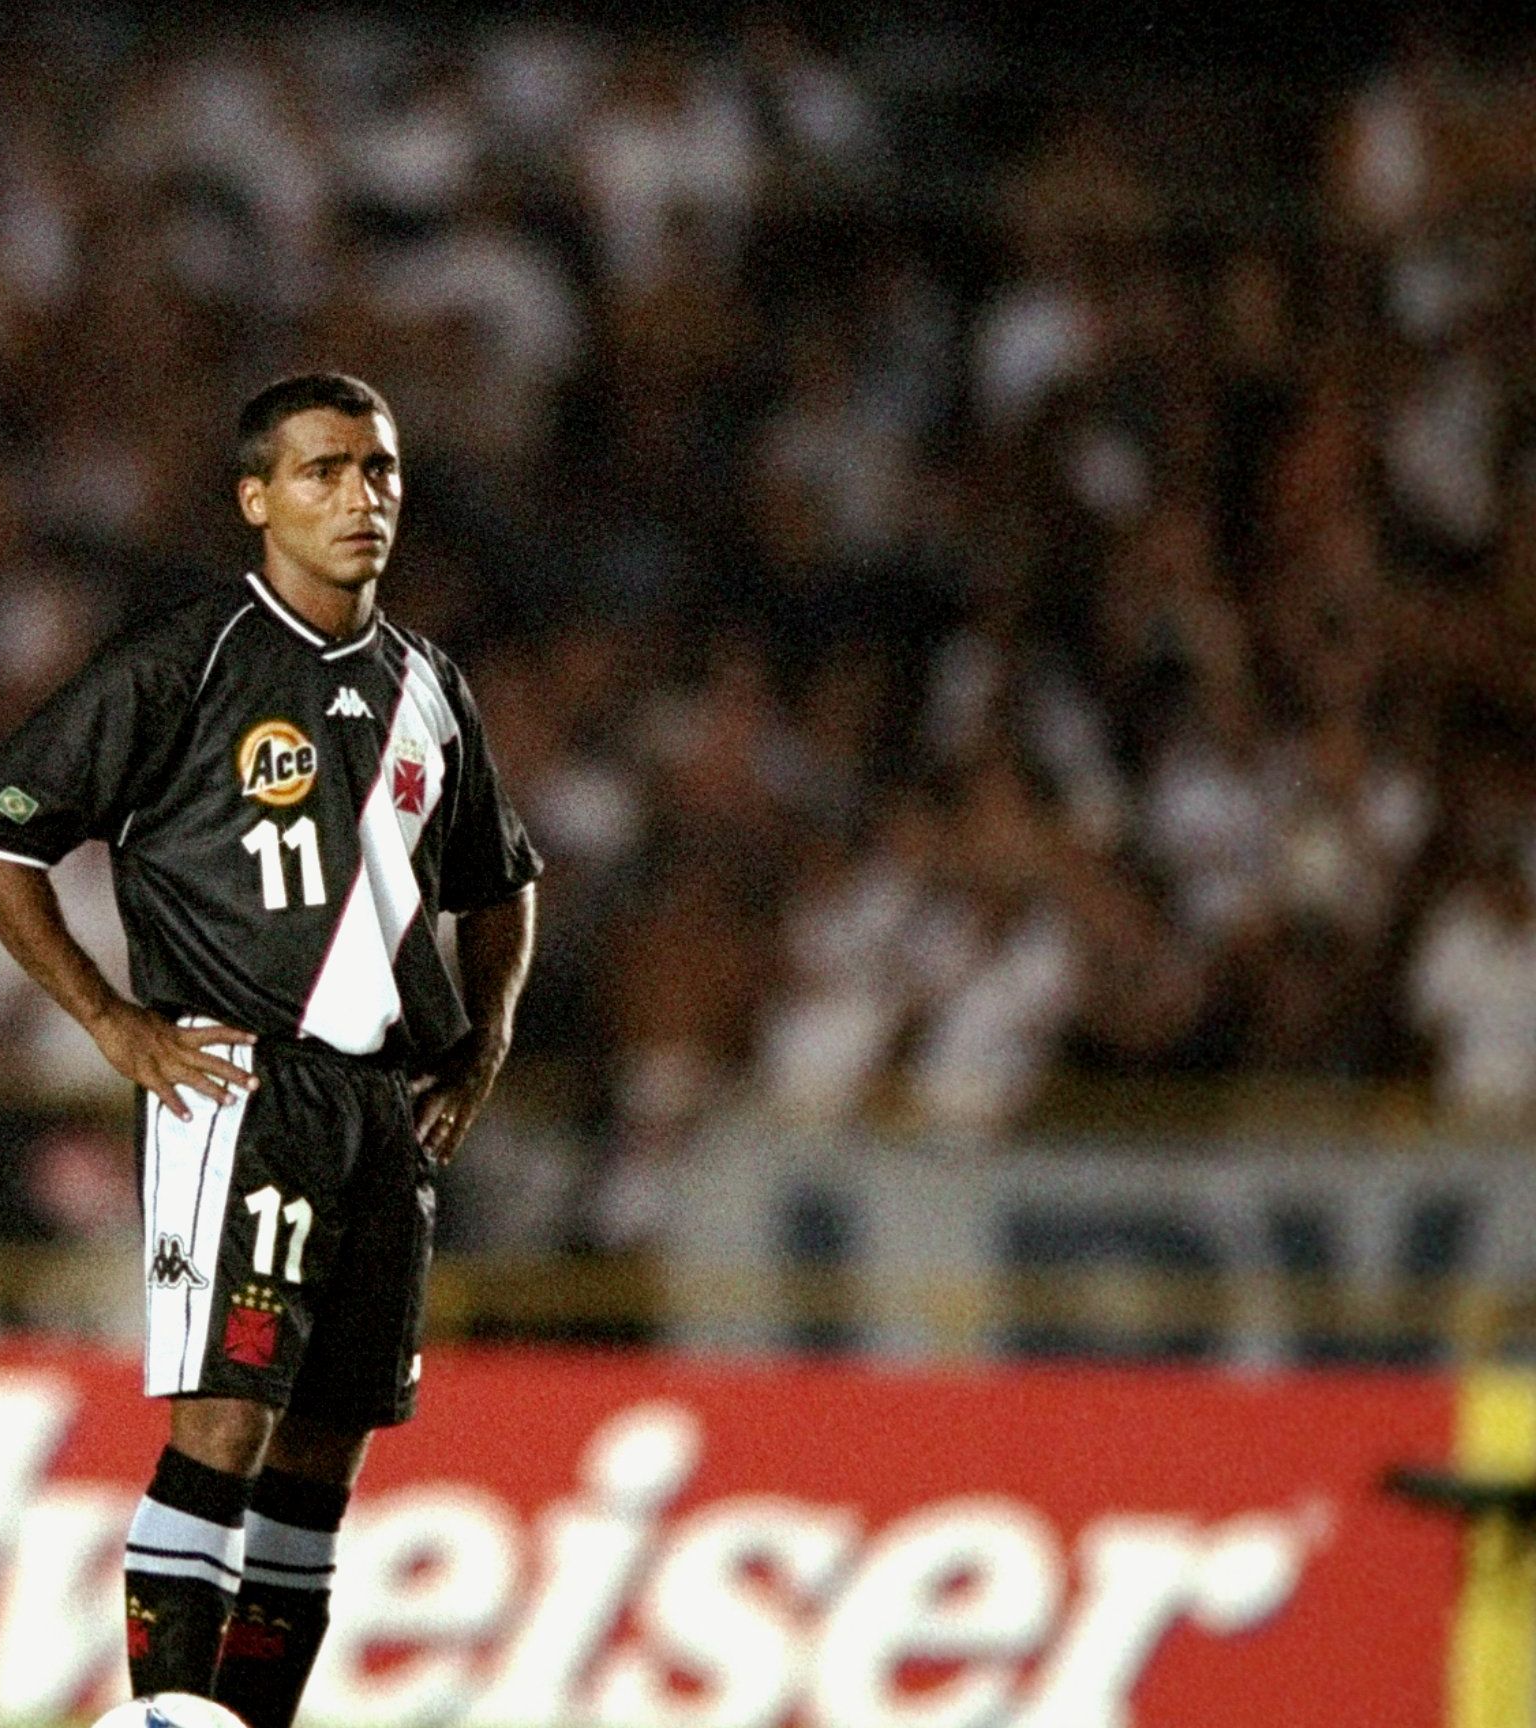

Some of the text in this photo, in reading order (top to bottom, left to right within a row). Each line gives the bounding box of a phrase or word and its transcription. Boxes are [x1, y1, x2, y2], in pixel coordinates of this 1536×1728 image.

[245, 737, 315, 791] Ace
[240, 815, 327, 911] 11
[244, 1184, 313, 1284] 11
